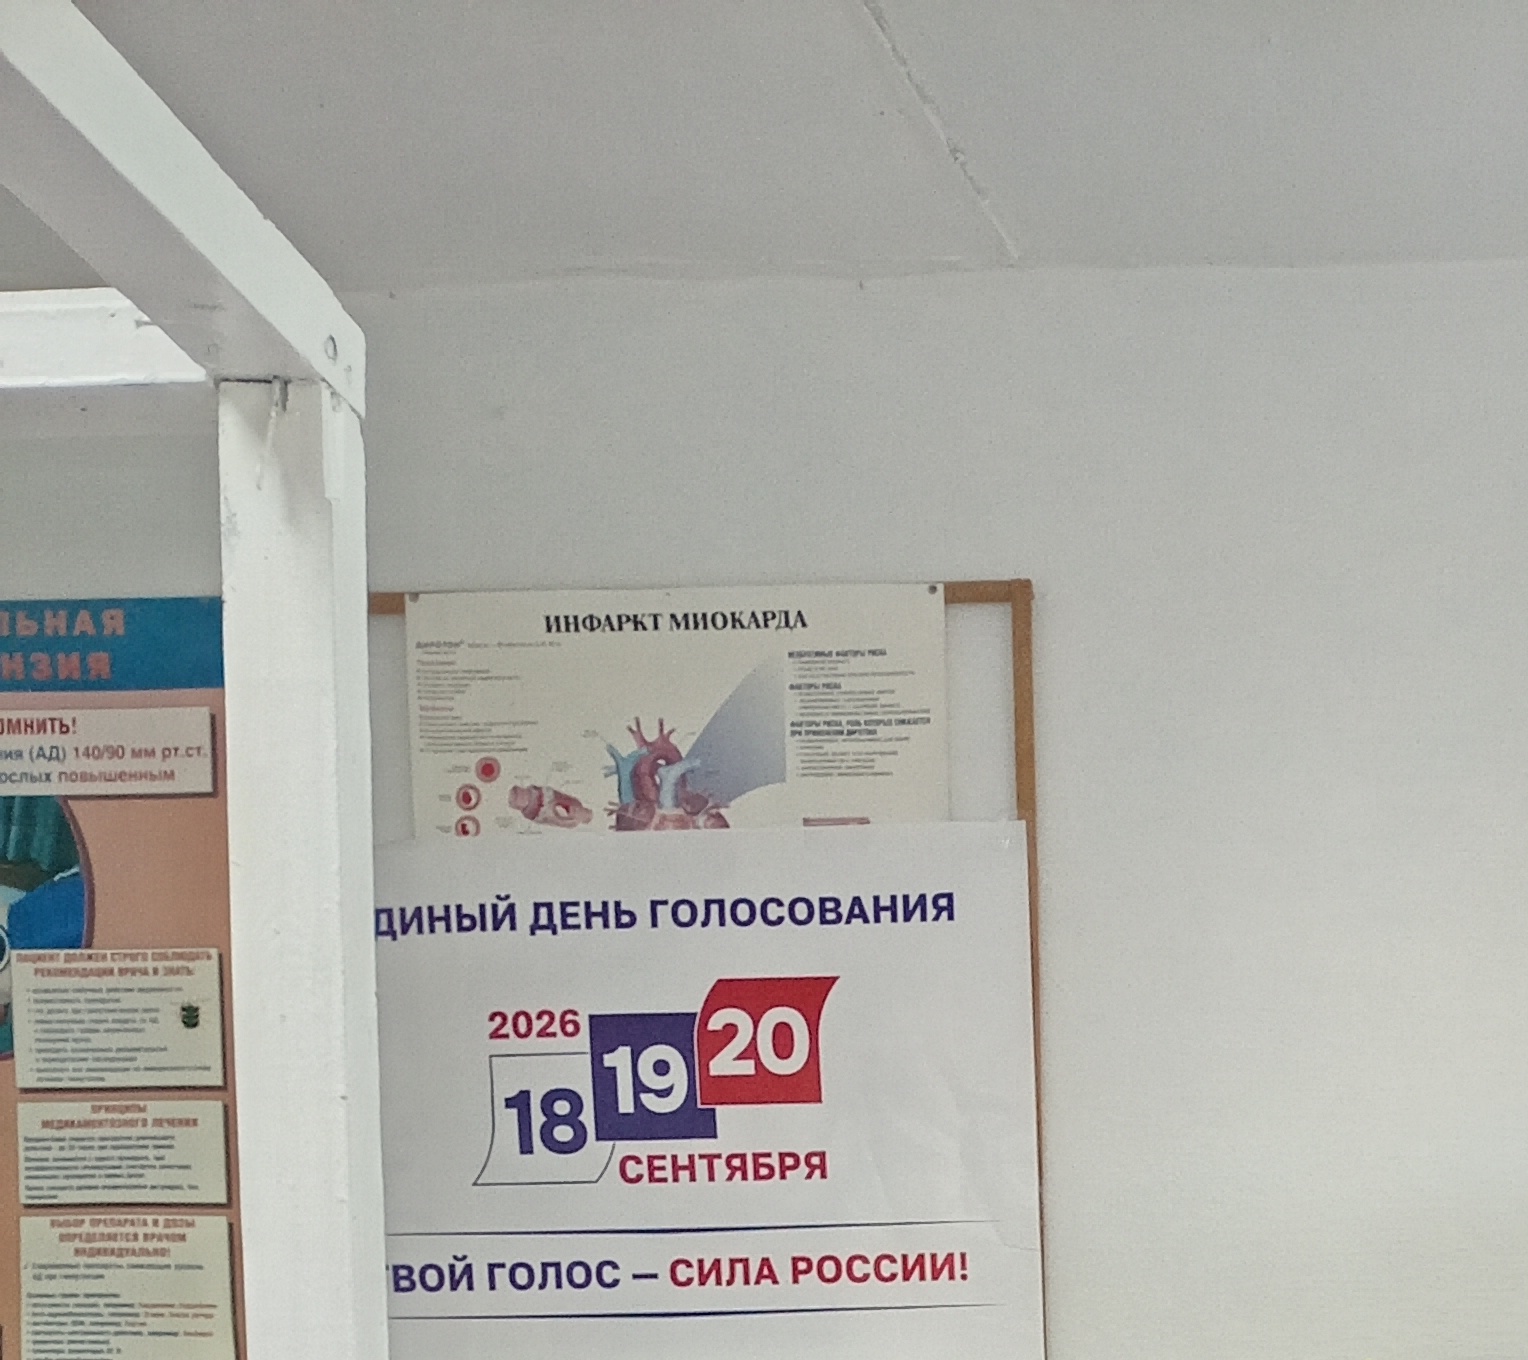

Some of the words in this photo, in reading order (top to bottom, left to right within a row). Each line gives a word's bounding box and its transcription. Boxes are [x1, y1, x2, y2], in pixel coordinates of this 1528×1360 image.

[544, 613, 662, 634] ИНФАРКТ
[669, 609, 809, 632] МИОКАРДА
[29, 744, 66, 764] (АД)
[73, 744, 125, 760] 140/90
[130, 748, 157, 759] мм
[58, 769, 175, 784] повышенным
[529, 900, 637, 936] ДЕНЬ
[650, 892, 956, 930] ГОЛОСОВАНИЯ
[487, 1008, 582, 1040] 2026
[504, 1088, 588, 1156] 18
[602, 1042, 689, 1114] 19
[706, 1005, 811, 1077] 20
[618, 1150, 829, 1185] СЕНТЯБРЯ
[387, 1255, 475, 1293] ВОЙ
[487, 1259, 622, 1291] ГОЛОС
[669, 1256, 780, 1288] СИЛА
[790, 1252, 969, 1286] РОССИИ!
